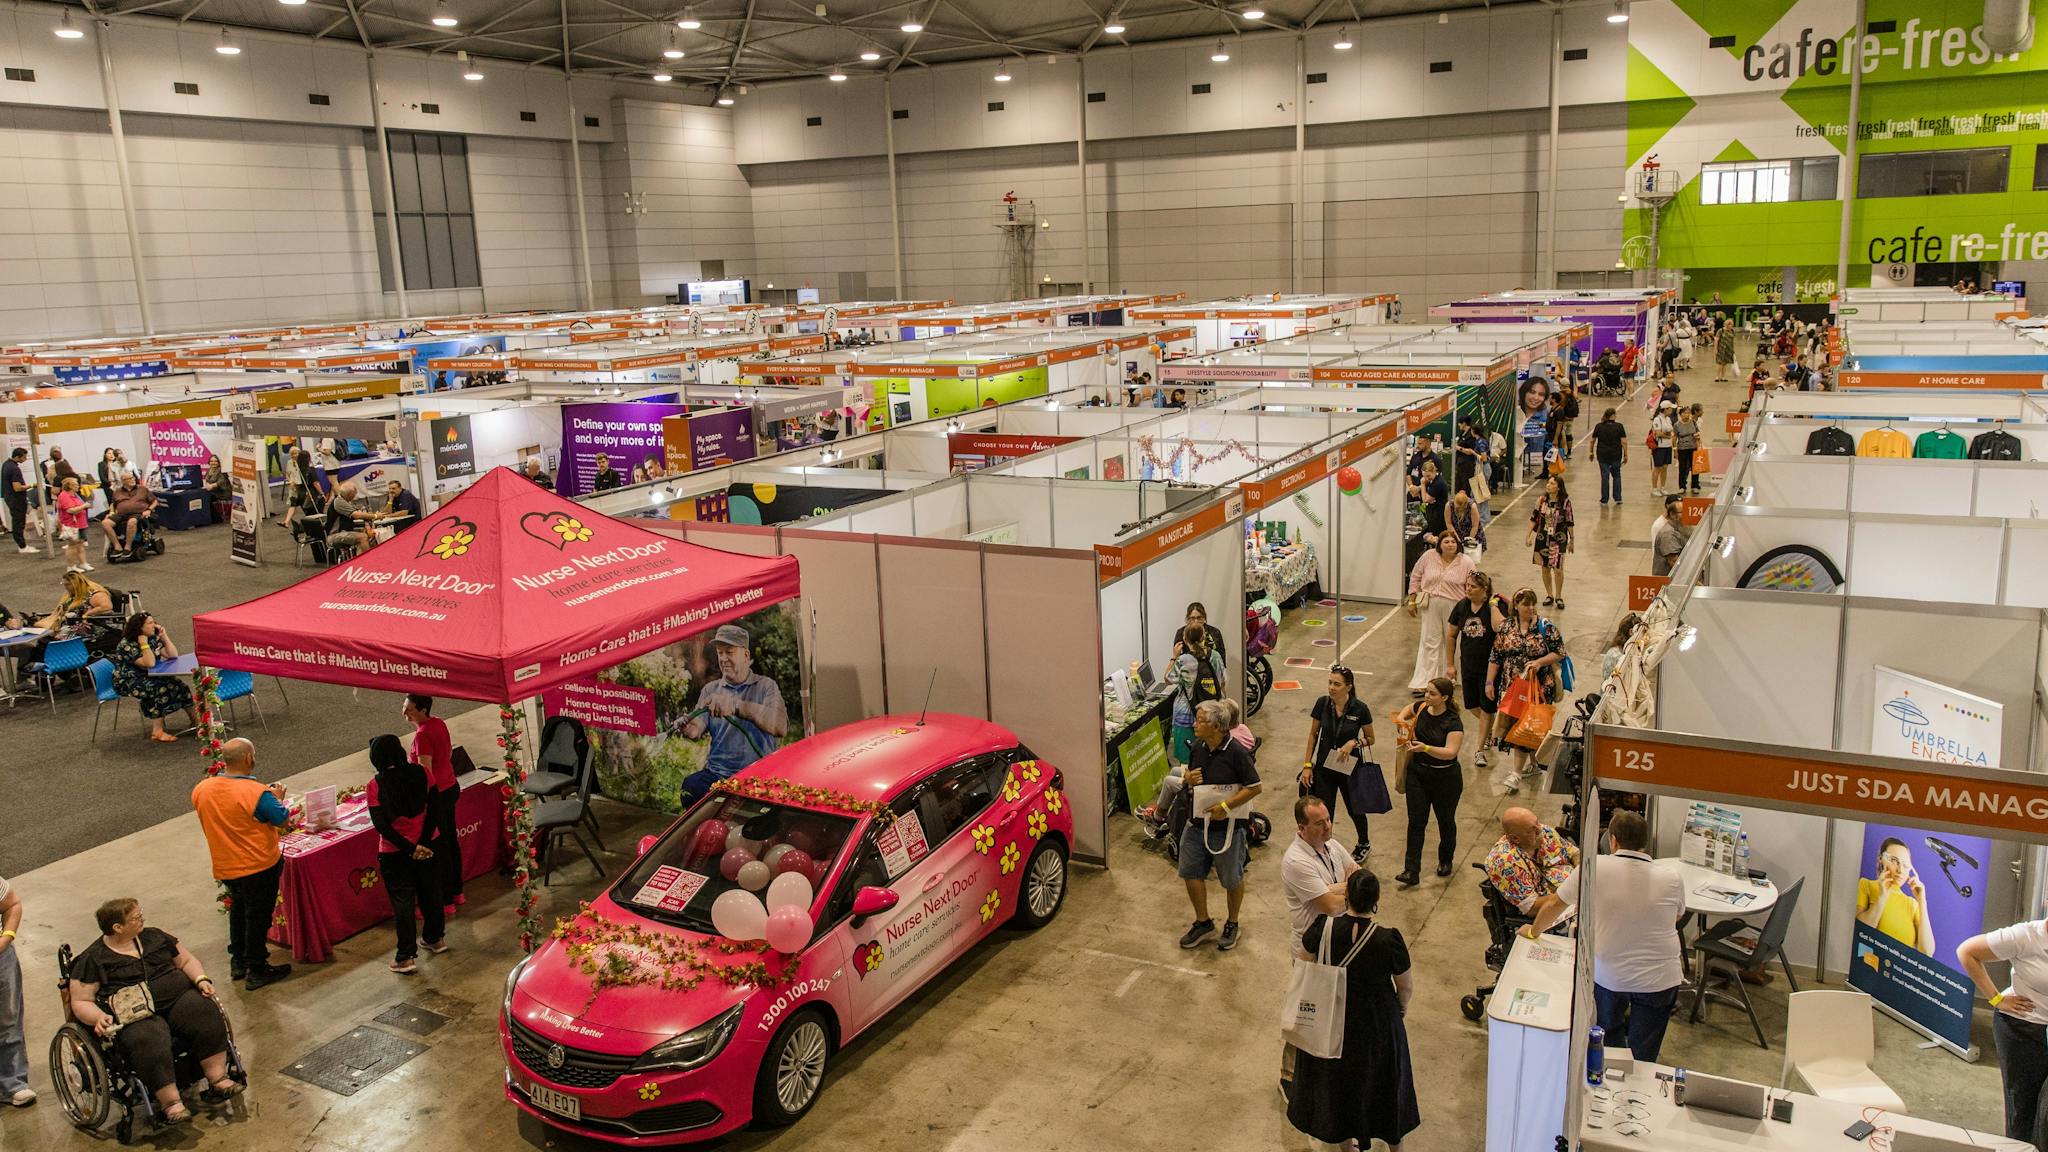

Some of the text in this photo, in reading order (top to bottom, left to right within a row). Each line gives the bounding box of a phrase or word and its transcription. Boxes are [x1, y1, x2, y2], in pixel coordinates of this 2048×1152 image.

[1743, 18, 2020, 81] cafe re-fres
[1869, 226, 1942, 264] cafe
[1757, 280, 1783, 294] cafe
[1919, 377, 1930, 385] AT
[1932, 377, 1958, 385] HOME
[1959, 377, 1985, 385] CARE
[115, 410, 154, 420] EMPLOYMENT
[155, 408, 182, 416] SERVICES
[1730, 419, 1742, 427] 122
[573, 418, 603, 430] Define
[605, 421, 626, 433] your
[627, 423, 647, 432] own
[149, 428, 195, 445] Looking
[575, 433, 592, 444] and
[594, 434, 618, 447] enjoy
[620, 437, 644, 445] more
[646, 435, 656, 446] of
[696, 435, 705, 445] My
[152, 443, 204, 458] for work?
[666, 444, 677, 454] My
[696, 445, 705, 455] My
[668, 462, 678, 471] My
[1247, 490, 1260, 500] 100
[1687, 506, 1704, 518] 124
[337, 566, 392, 585] Nurse
[391, 569, 441, 589] Next
[512, 566, 577, 592] Nurse
[571, 551, 623, 572] Next
[547, 579, 590, 599] home
[564, 566, 689, 607] nursenextdoor.com.au
[1636, 587, 1656, 599] 125
[319, 601, 447, 622] nursenextdoor.com.au
[559, 586, 764, 667] Home Care that is #Making Lives Better
[233, 642, 448, 680] Home Care that is #Making Lives Better
[565, 696, 594, 709] Home
[608, 702, 626, 714] that
[625, 706, 634, 716] is
[602, 688, 649, 704] possibility.
[559, 707, 591, 722] Making
[613, 715, 641, 729] Better.
[1901, 726, 1988, 766] UMBRELLA
[1612, 748, 2048, 820] 125 JUST SDA MANAG
[886, 872, 977, 944] Nurse Next Door
[889, 938, 912, 960] home
[757, 978, 831, 1032] 1300 100 247
[540, 1011, 604, 1039] Making Lives Better
